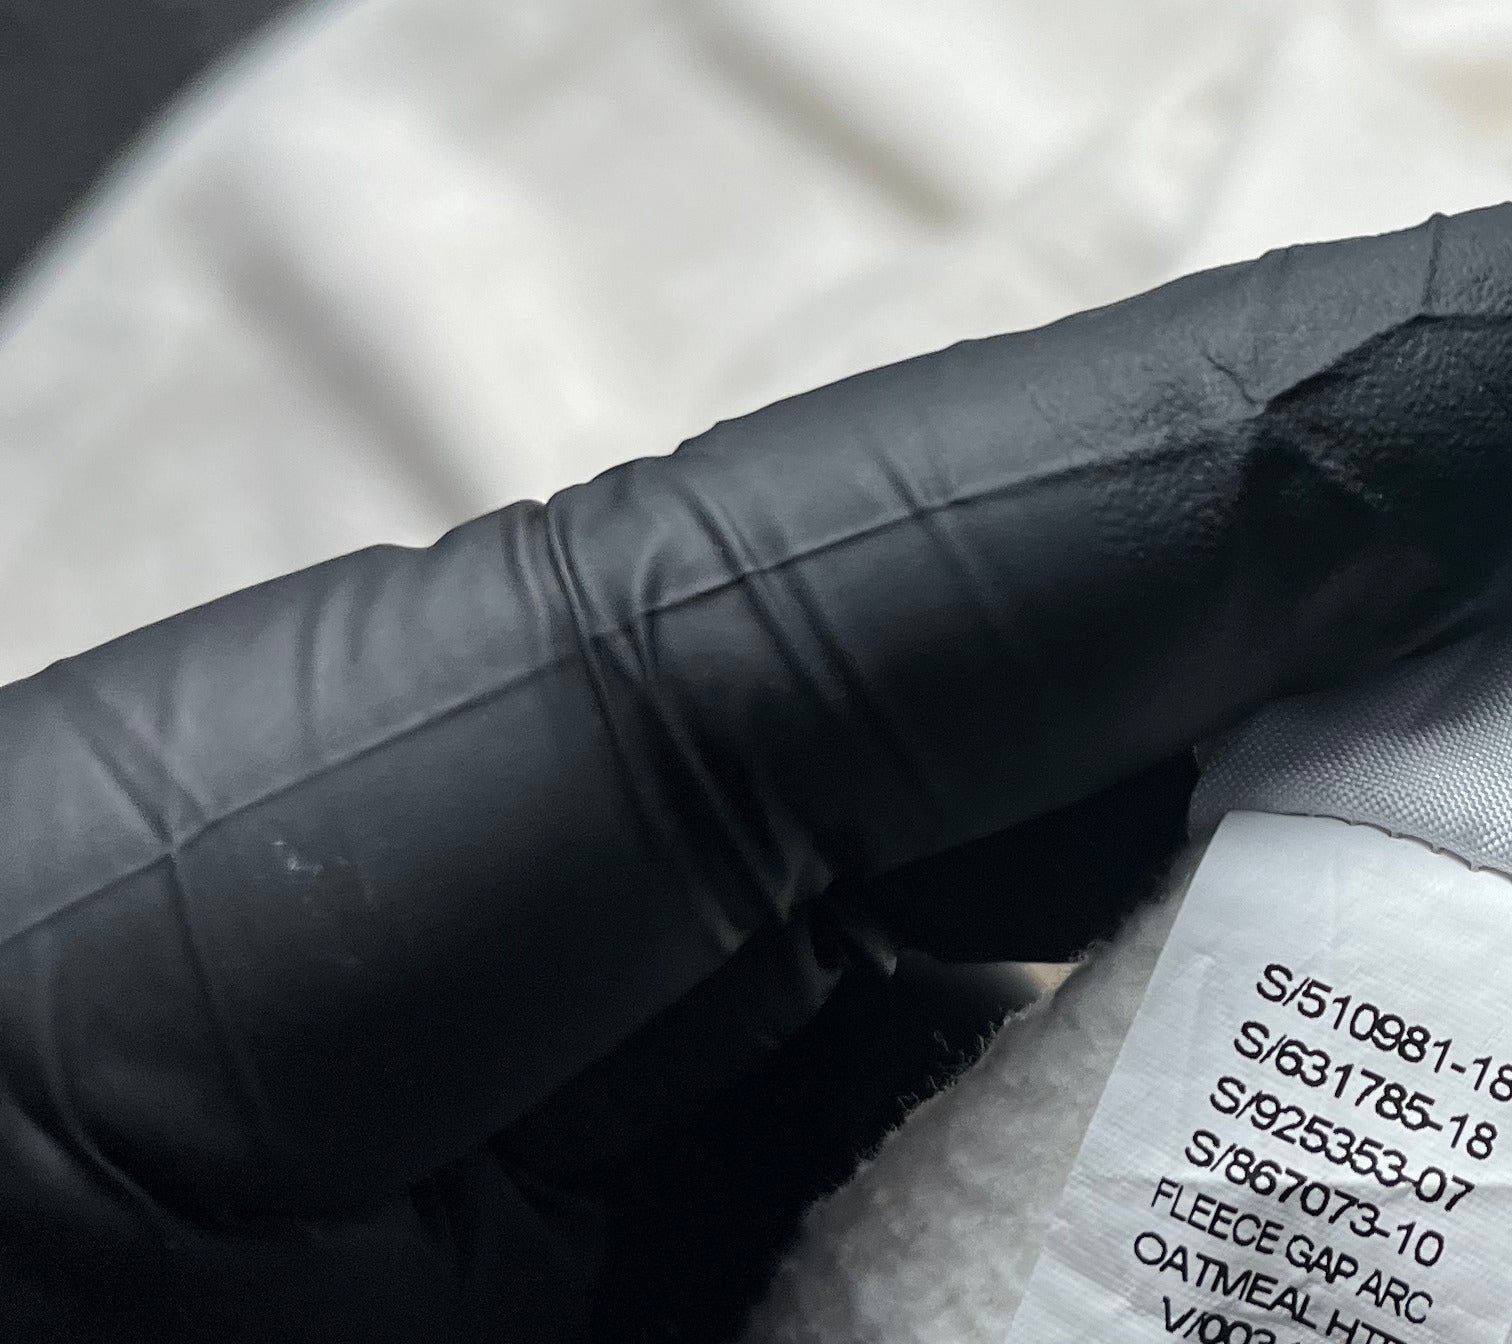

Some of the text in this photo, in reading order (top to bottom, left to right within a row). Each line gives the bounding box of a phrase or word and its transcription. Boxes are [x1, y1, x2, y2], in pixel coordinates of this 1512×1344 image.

[1210, 1076, 1475, 1212] S/925353-07
[1234, 1021, 1498, 1160] S/631785-18
[1151, 1176, 1434, 1324] FLEECE GAP ARC
[1185, 1129, 1444, 1267] S/867073-10
[1134, 1231, 1317, 1330] OATMEAL
